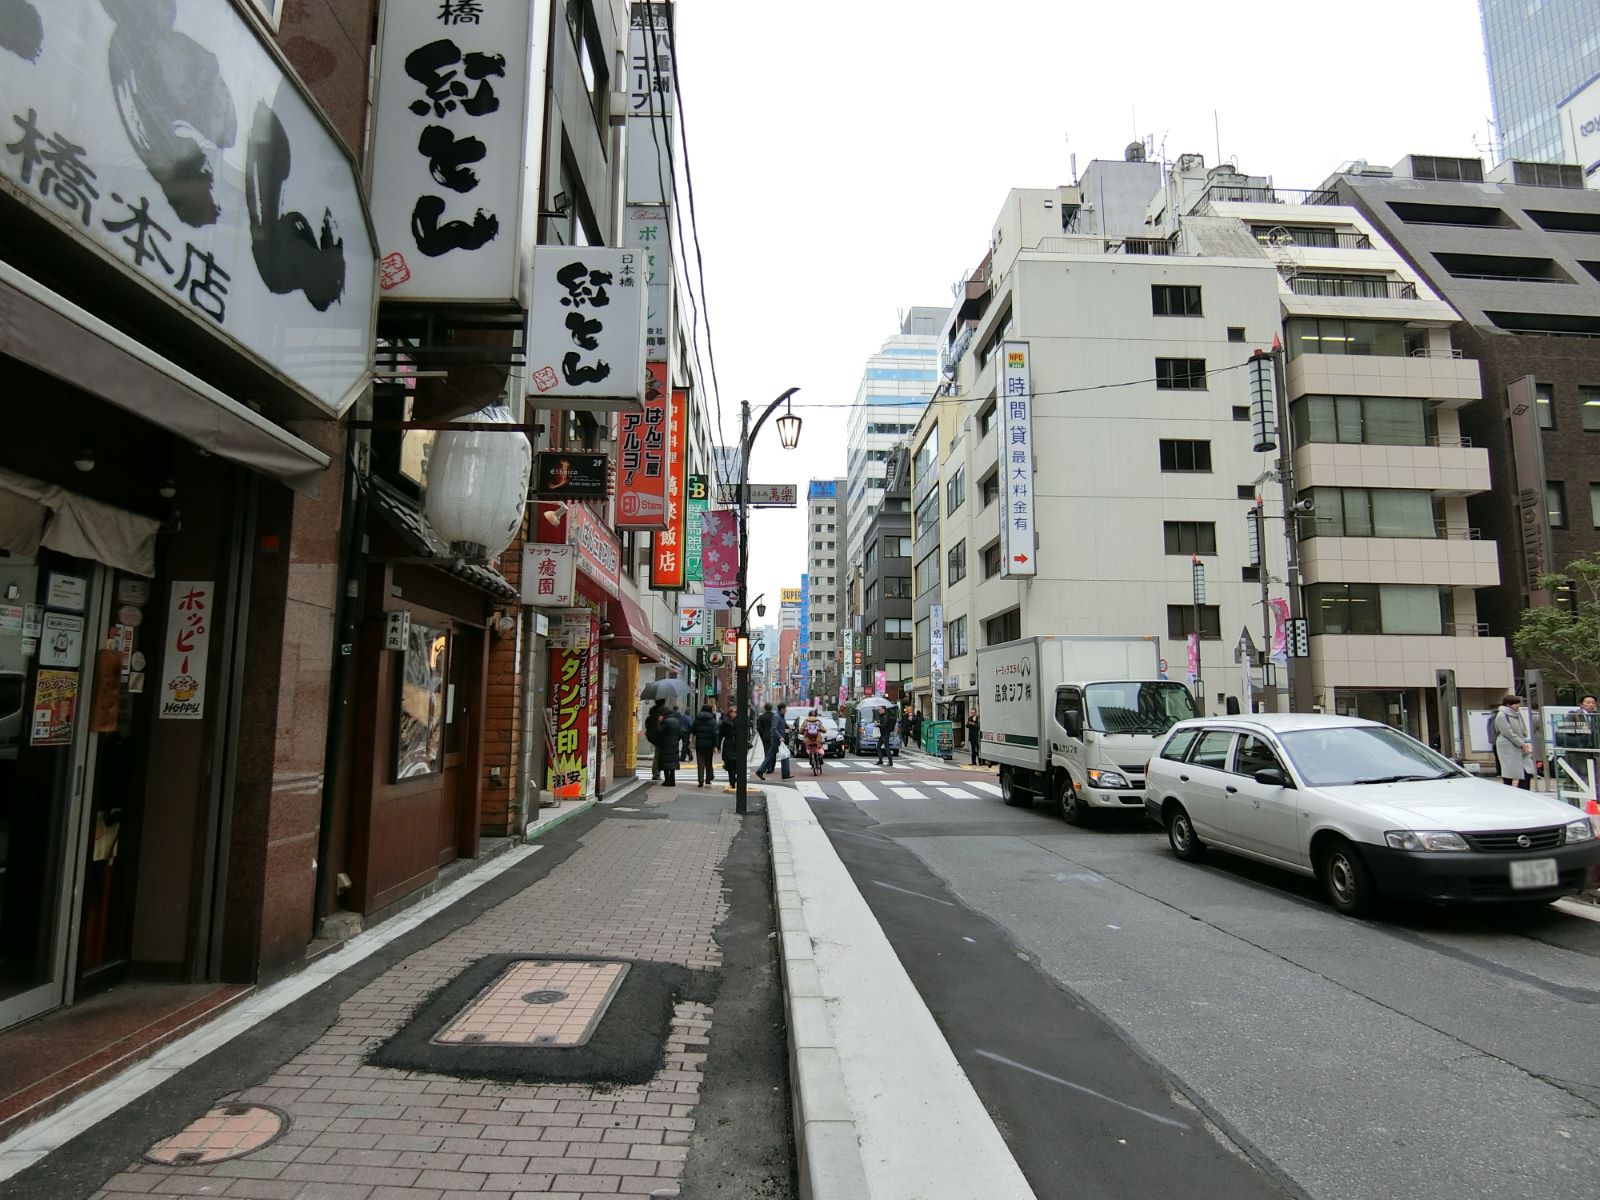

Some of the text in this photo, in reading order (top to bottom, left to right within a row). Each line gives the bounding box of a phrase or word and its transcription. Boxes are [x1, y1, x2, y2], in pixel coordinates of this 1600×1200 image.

[619, 253, 635, 287] 日本橋
[592, 459, 603, 467] 2F
[176, 585, 206, 674] ホッピー
